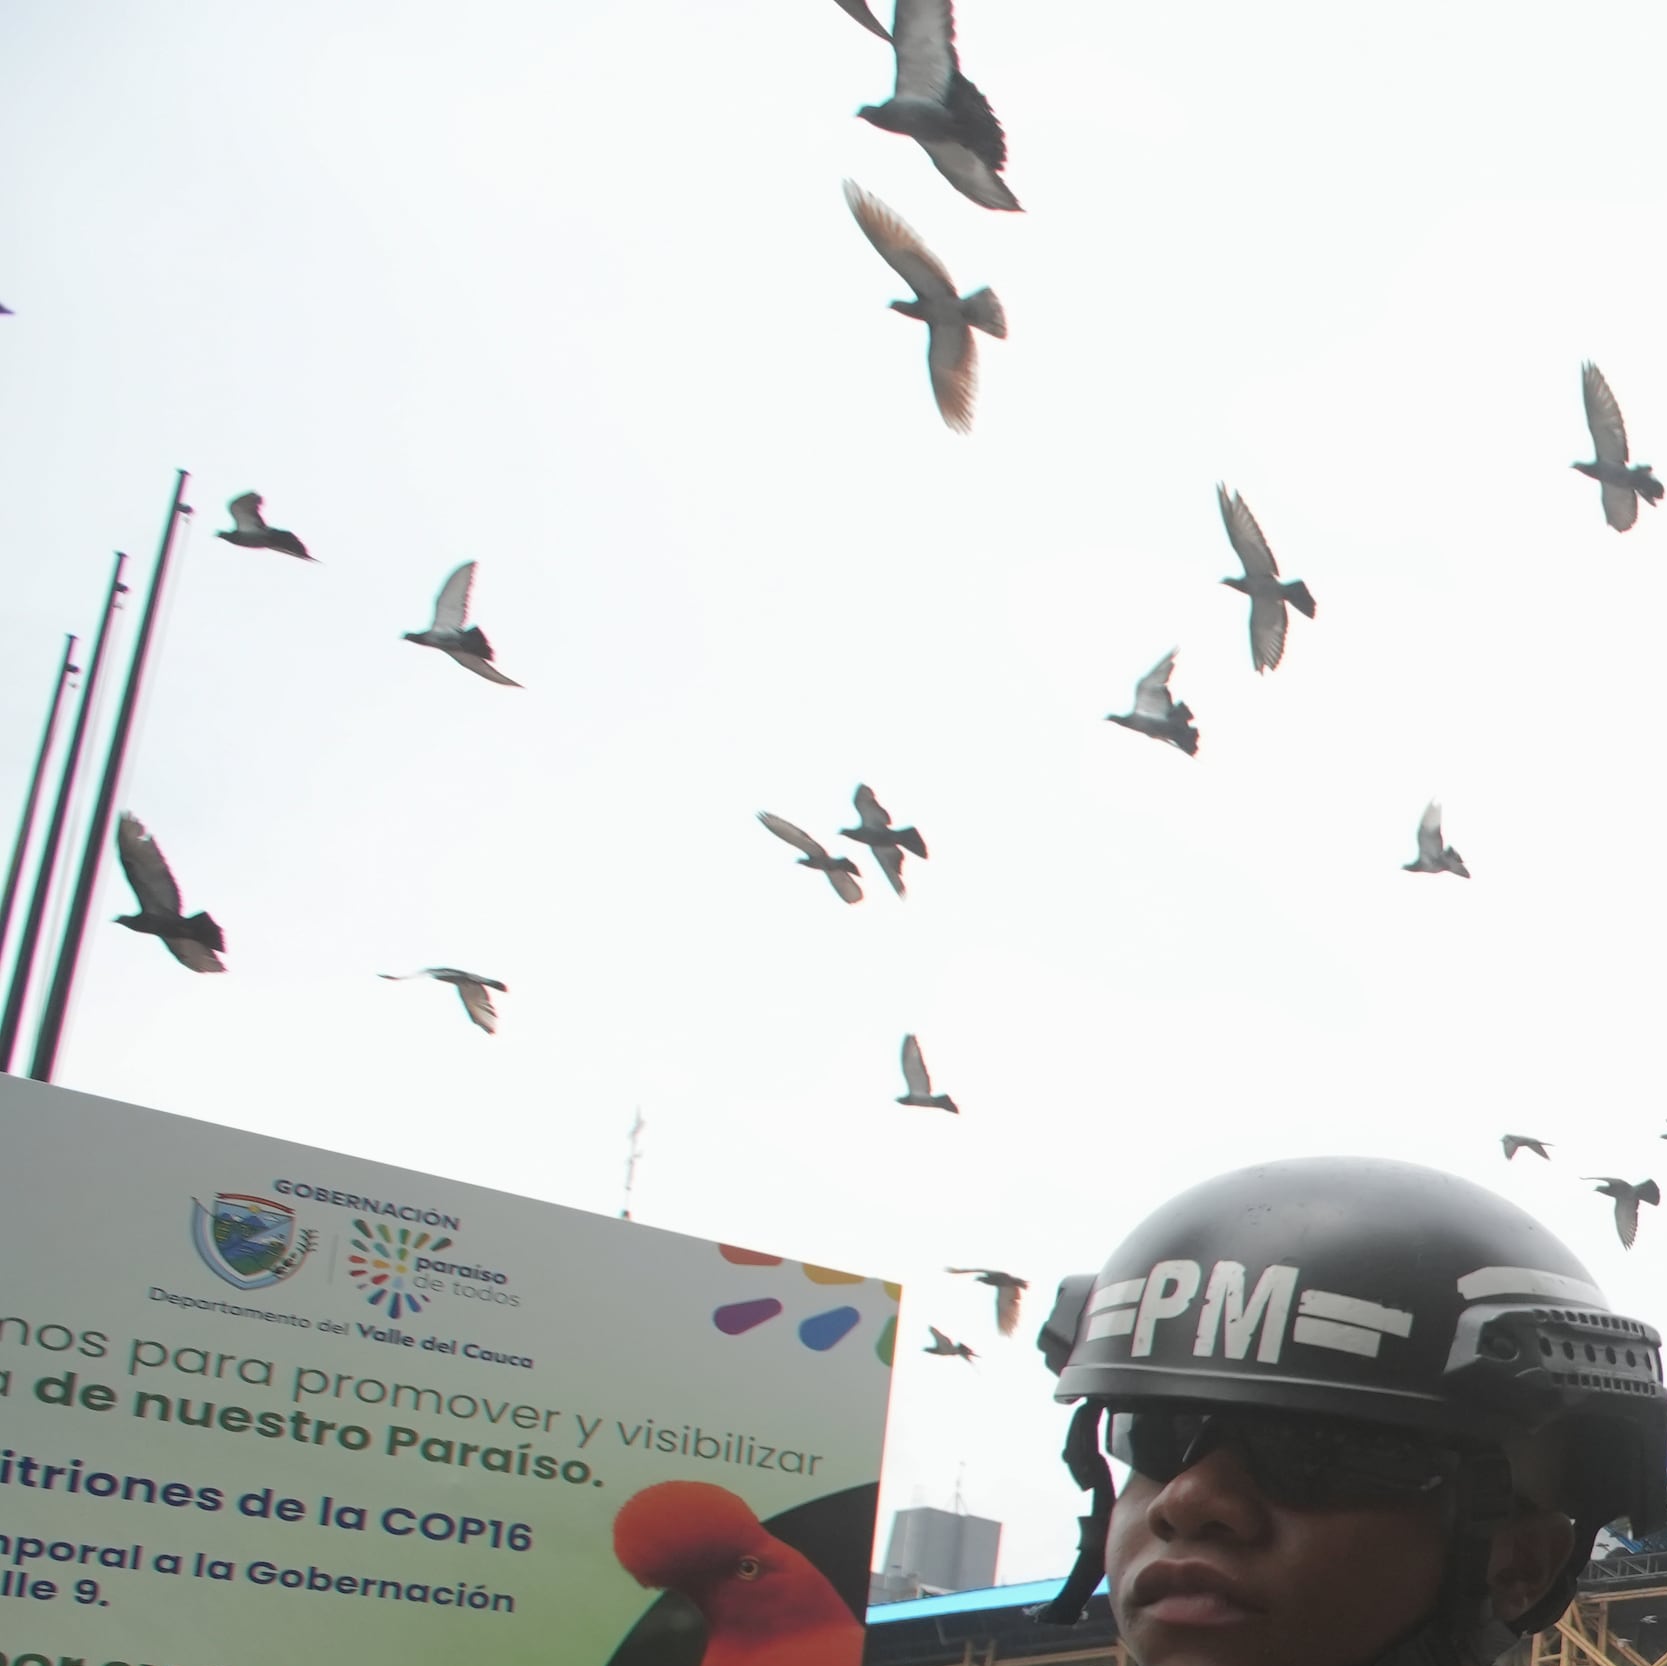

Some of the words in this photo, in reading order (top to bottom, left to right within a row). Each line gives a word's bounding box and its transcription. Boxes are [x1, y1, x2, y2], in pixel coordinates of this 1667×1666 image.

[273, 1178, 461, 1232] GOBERNACIÓN
[413, 1273, 445, 1293] de
[453, 1281, 521, 1308] todos
[1129, 1258, 1300, 1365] PM
[149, 1285, 311, 1330] Departamento
[317, 1317, 350, 1337] del
[356, 1322, 416, 1349] Valle
[421, 1334, 457, 1356] del
[462, 1342, 535, 1370] Cauca
[34, 1370, 118, 1413] de
[133, 1389, 372, 1452] nuestro
[386, 1424, 605, 1488] Paraíso.
[127, 1336, 275, 1387] para
[293, 1365, 561, 1434] promover
[574, 1411, 604, 1448] y
[615, 1417, 824, 1476] visibilizar
[237, 1487, 306, 1523] de
[318, 1495, 368, 1532] la
[380, 1506, 534, 1553] COP16
[74, 1578, 111, 1608] 9.
[153, 1553, 183, 1576] a
[193, 1552, 236, 1582] la
[247, 1560, 517, 1614] Gobernación
